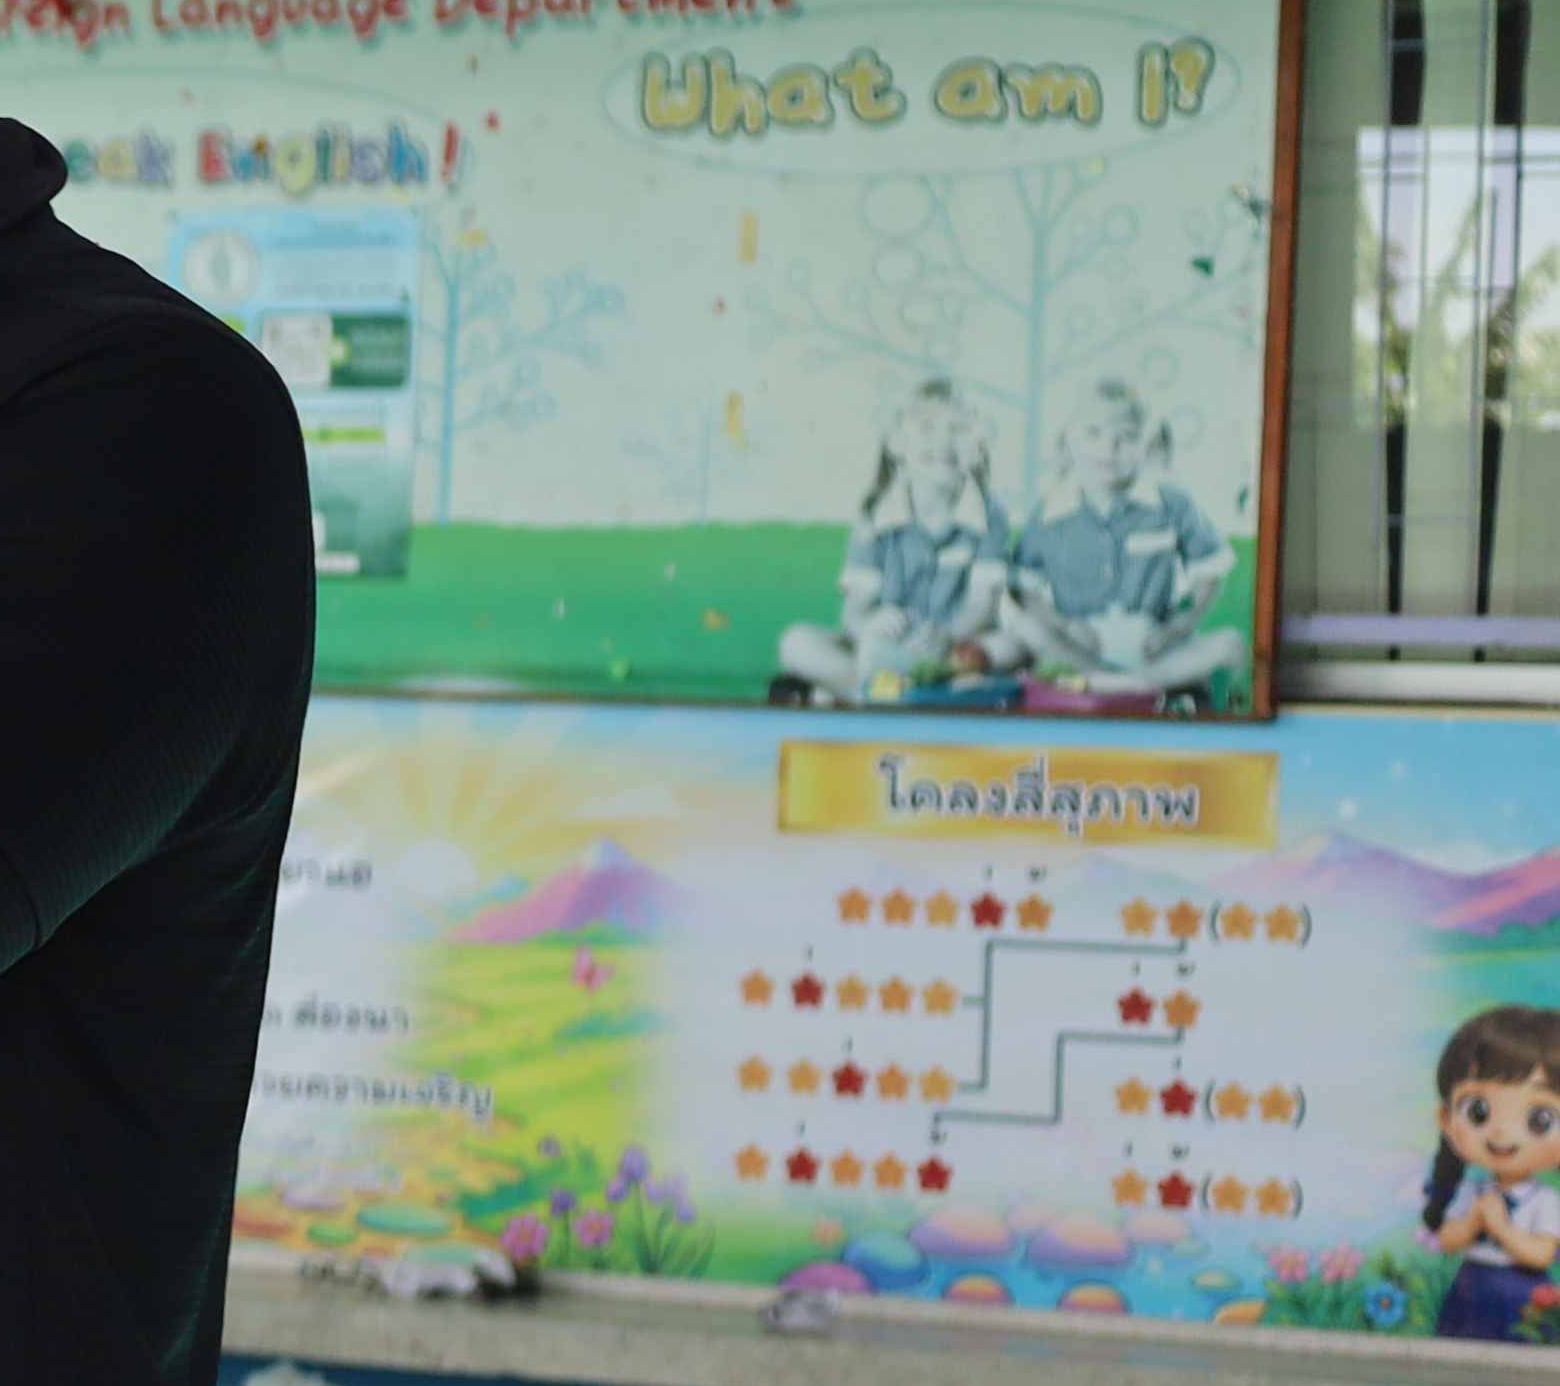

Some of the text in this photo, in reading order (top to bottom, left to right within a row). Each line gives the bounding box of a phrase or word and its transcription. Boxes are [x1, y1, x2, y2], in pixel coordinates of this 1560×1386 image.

[640, 43, 908, 139] What
[932, 56, 1104, 127] am
[60, 129, 174, 183] eak
[876, 753, 1200, 838] โคลงสี่สุภาพ
